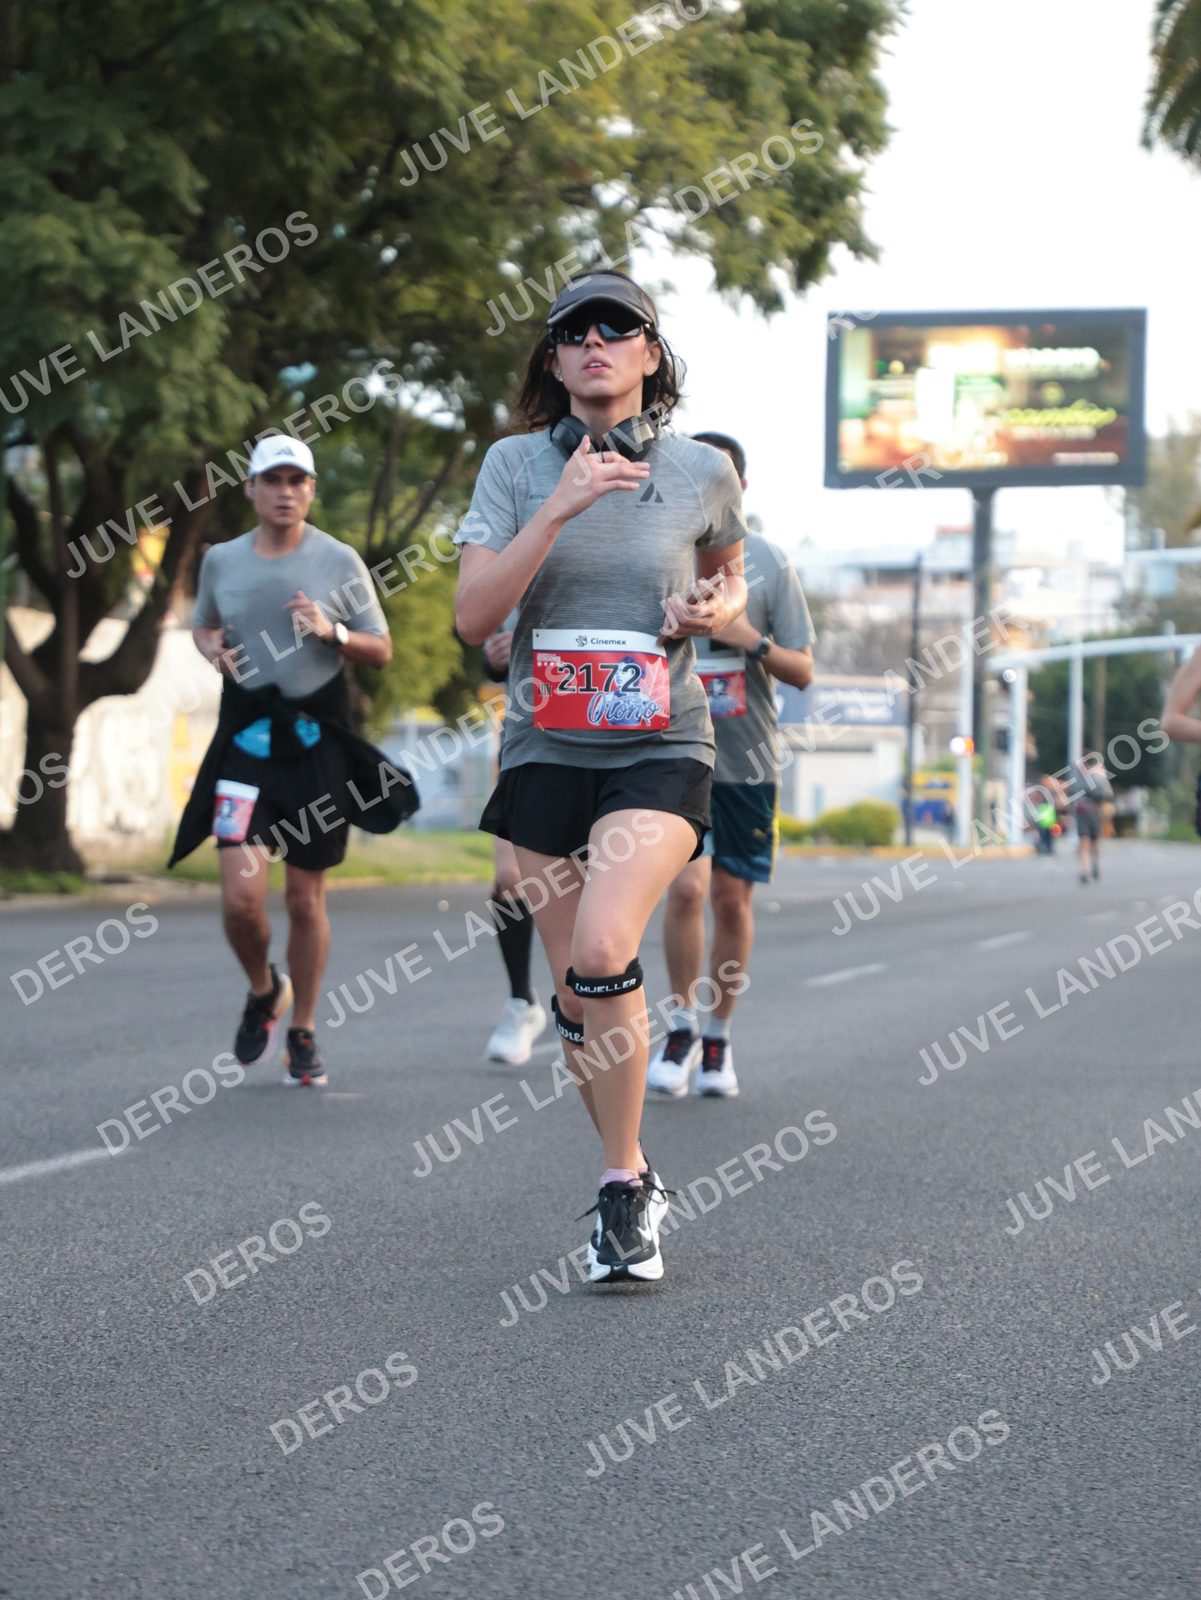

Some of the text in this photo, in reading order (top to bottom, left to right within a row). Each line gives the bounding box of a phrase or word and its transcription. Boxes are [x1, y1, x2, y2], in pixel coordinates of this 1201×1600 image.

[590, 637, 627, 646] Cinemex
[558, 662, 642, 694] 2172
[579, 977, 637, 993] MUELLER
